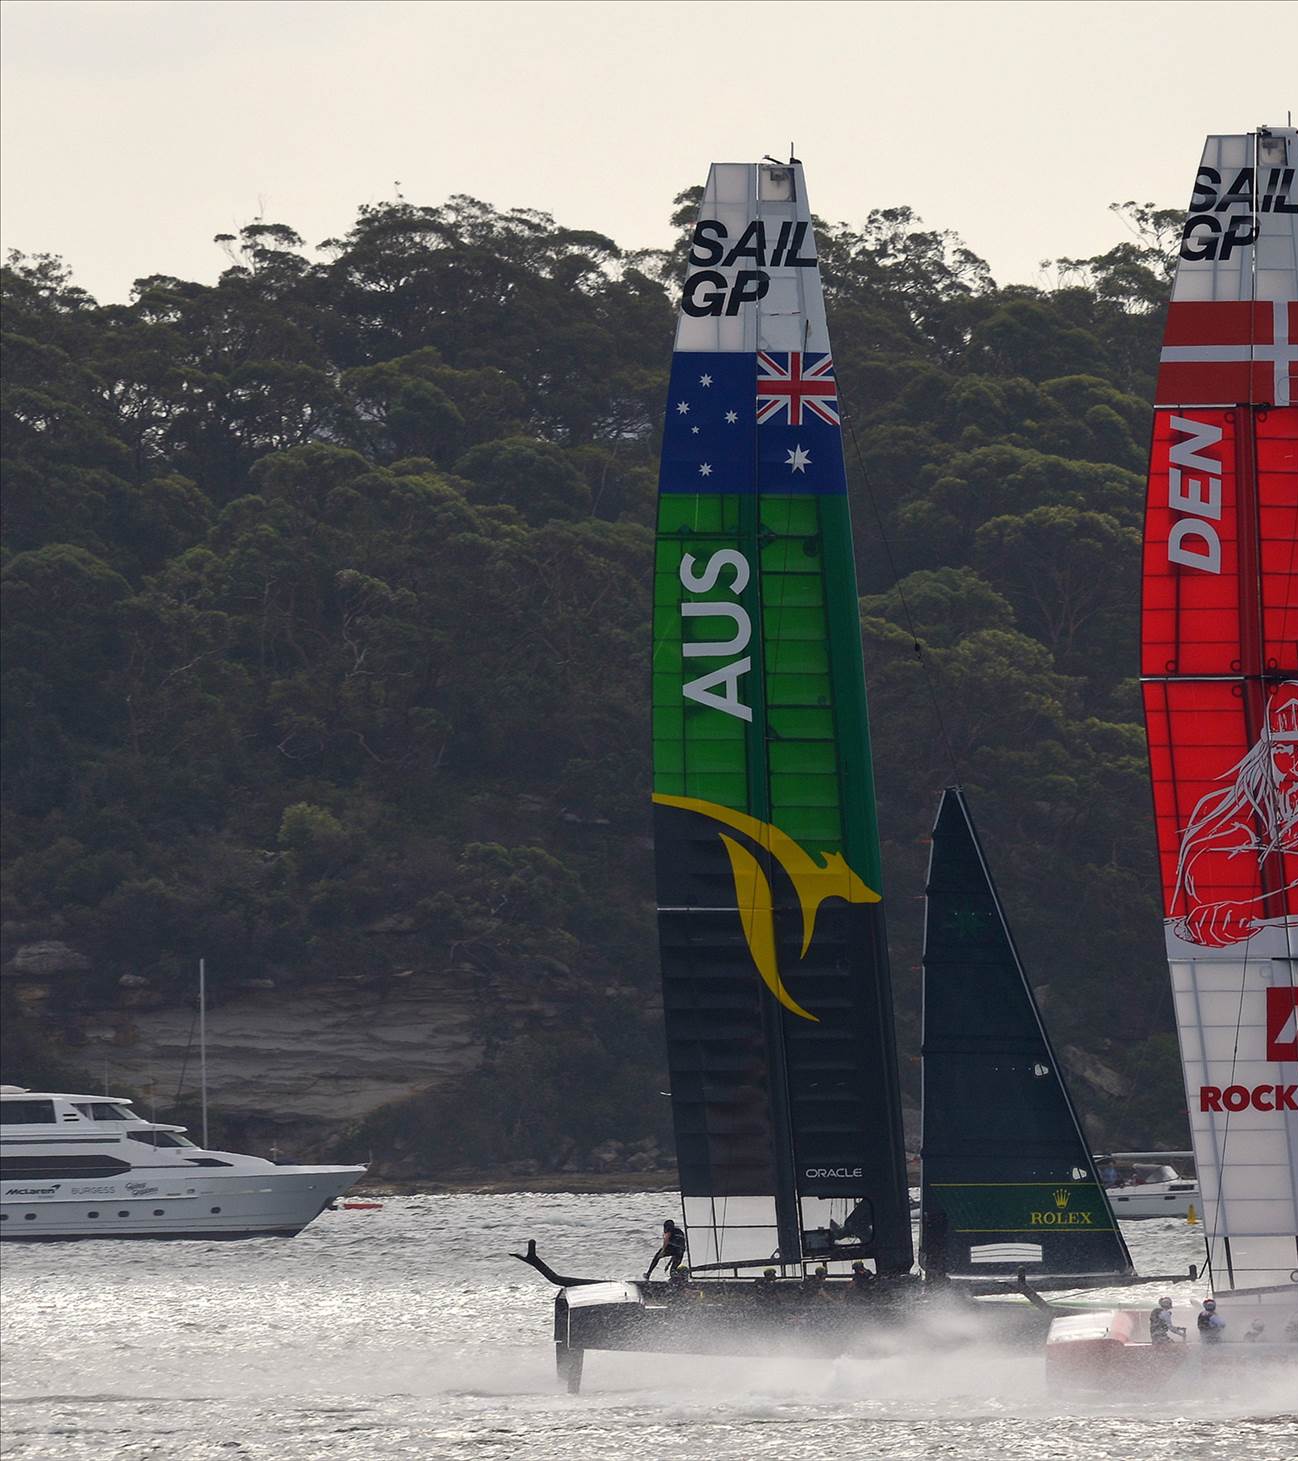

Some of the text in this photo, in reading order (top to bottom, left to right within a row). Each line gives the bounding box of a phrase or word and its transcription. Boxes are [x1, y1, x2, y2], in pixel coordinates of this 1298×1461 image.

[689, 220, 817, 267] SAIL
[1180, 214, 1262, 261] GP
[681, 270, 771, 317] GP
[1168, 415, 1222, 574] DEN
[680, 549, 752, 722] AUS
[806, 1168, 863, 1178] ORACLE
[1031, 1211, 1093, 1225] ROLEX
